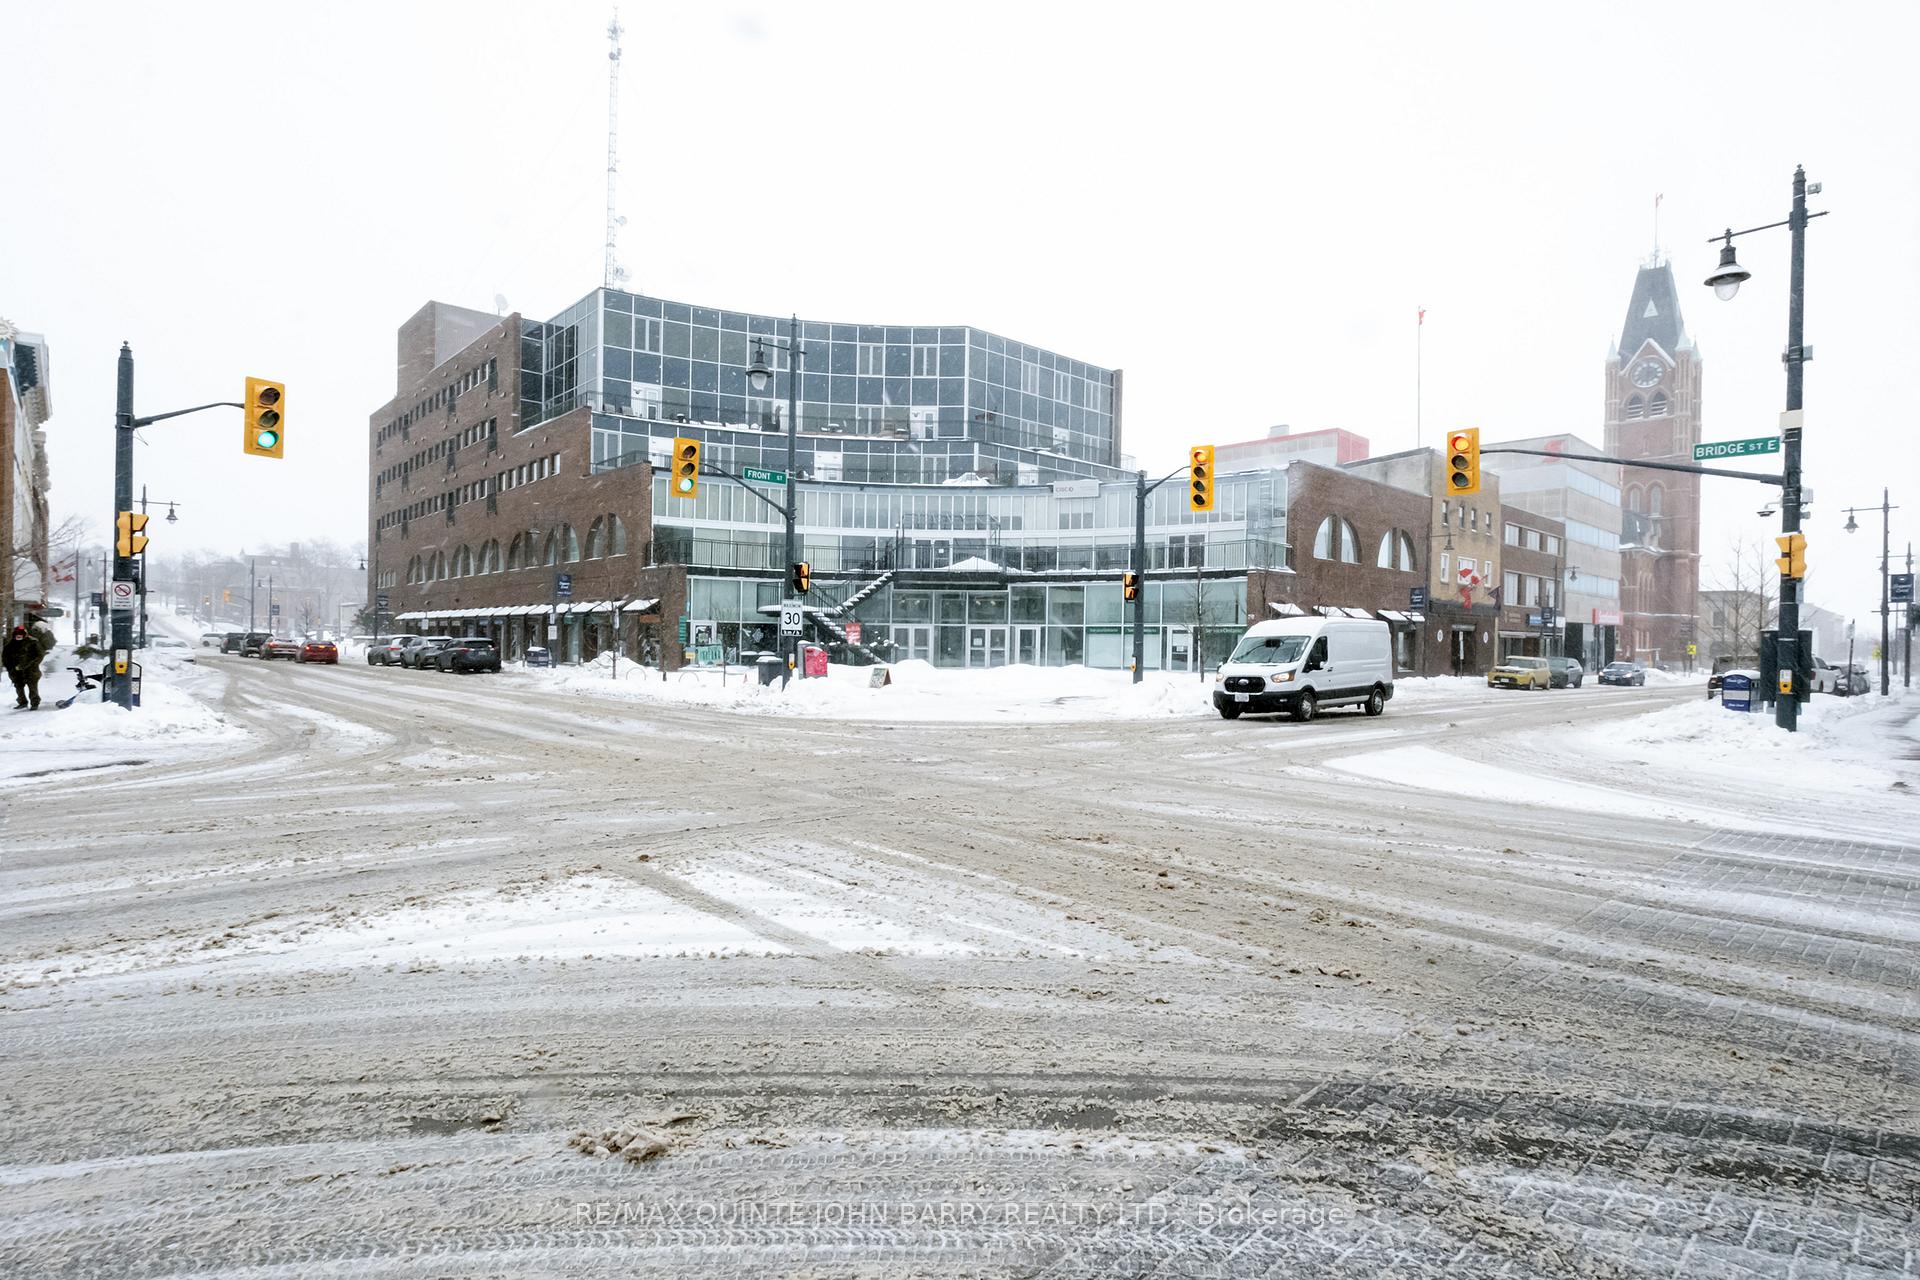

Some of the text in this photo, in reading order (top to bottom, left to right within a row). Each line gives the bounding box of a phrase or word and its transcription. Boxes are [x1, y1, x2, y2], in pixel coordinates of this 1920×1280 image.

[1696, 440, 1776, 457] BRIDGE ST E
[747, 470, 770, 480] FRONT
[784, 612, 800, 625] 30
